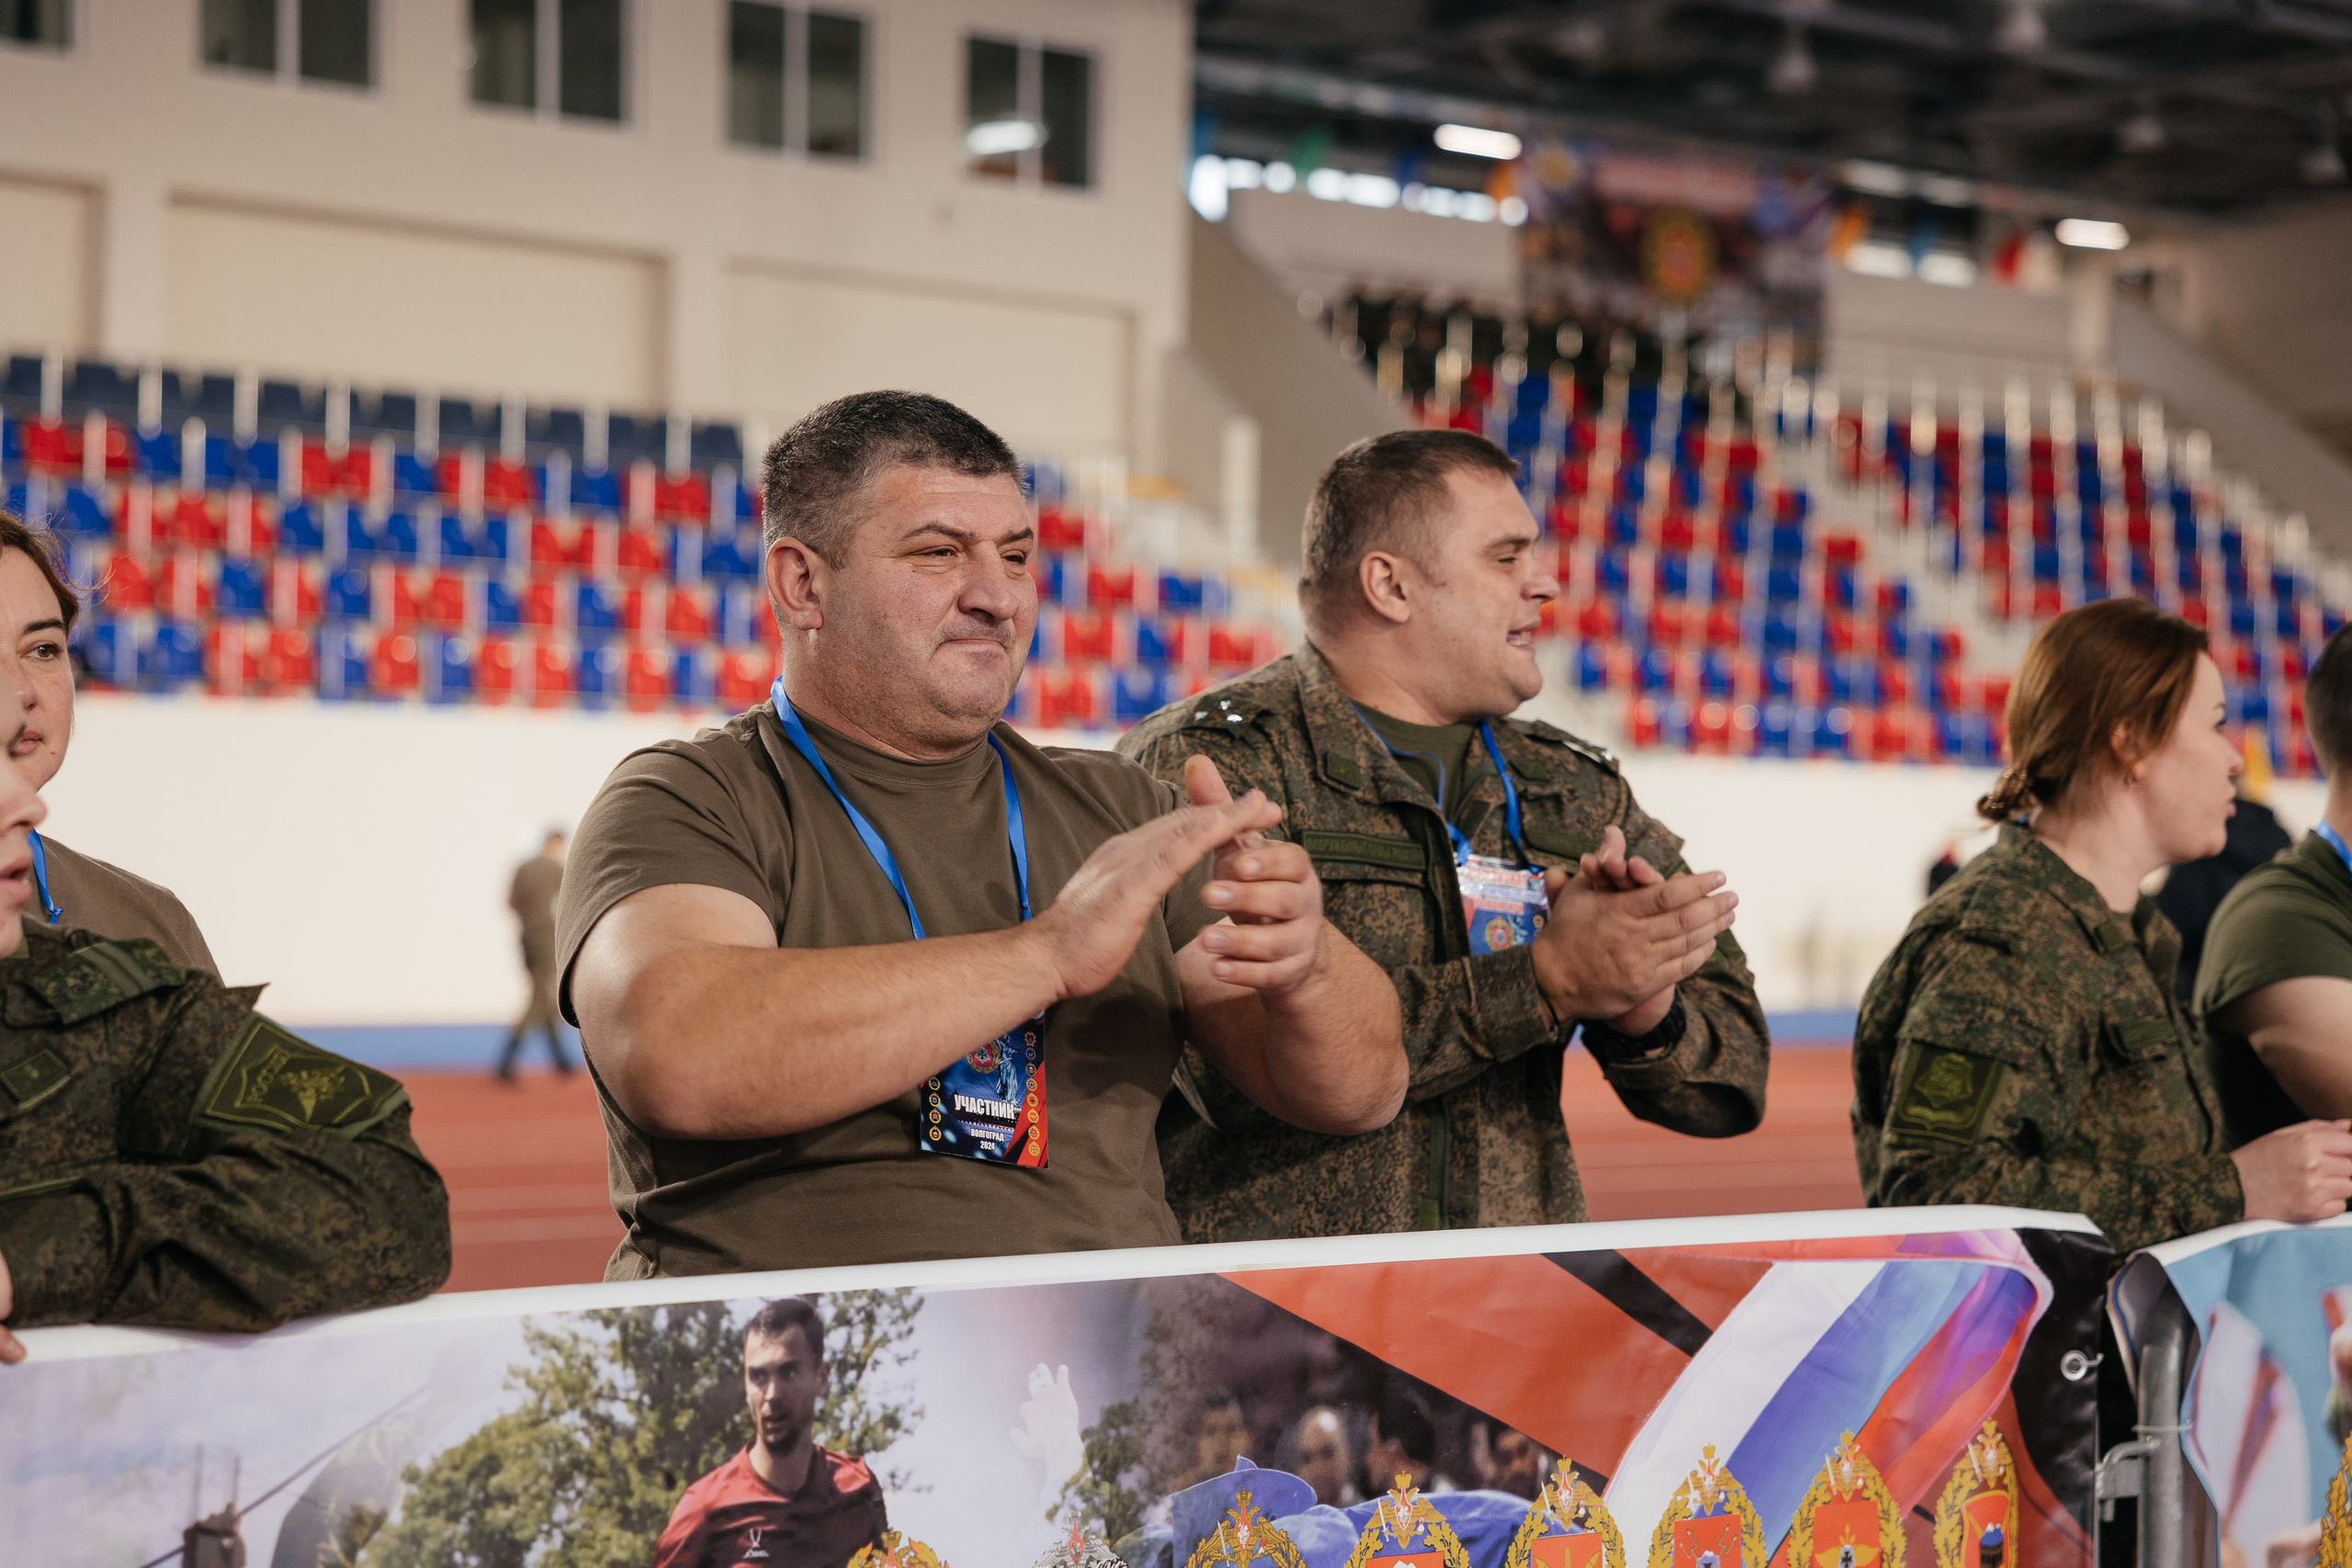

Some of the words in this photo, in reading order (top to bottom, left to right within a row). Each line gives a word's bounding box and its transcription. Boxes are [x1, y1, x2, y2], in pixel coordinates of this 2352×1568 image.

[954, 1094, 1015, 1120] УЧАСТНИК
[970, 1128, 1004, 1143] ВОЛГОГРАД
[979, 1141, 995, 1150] 2024
